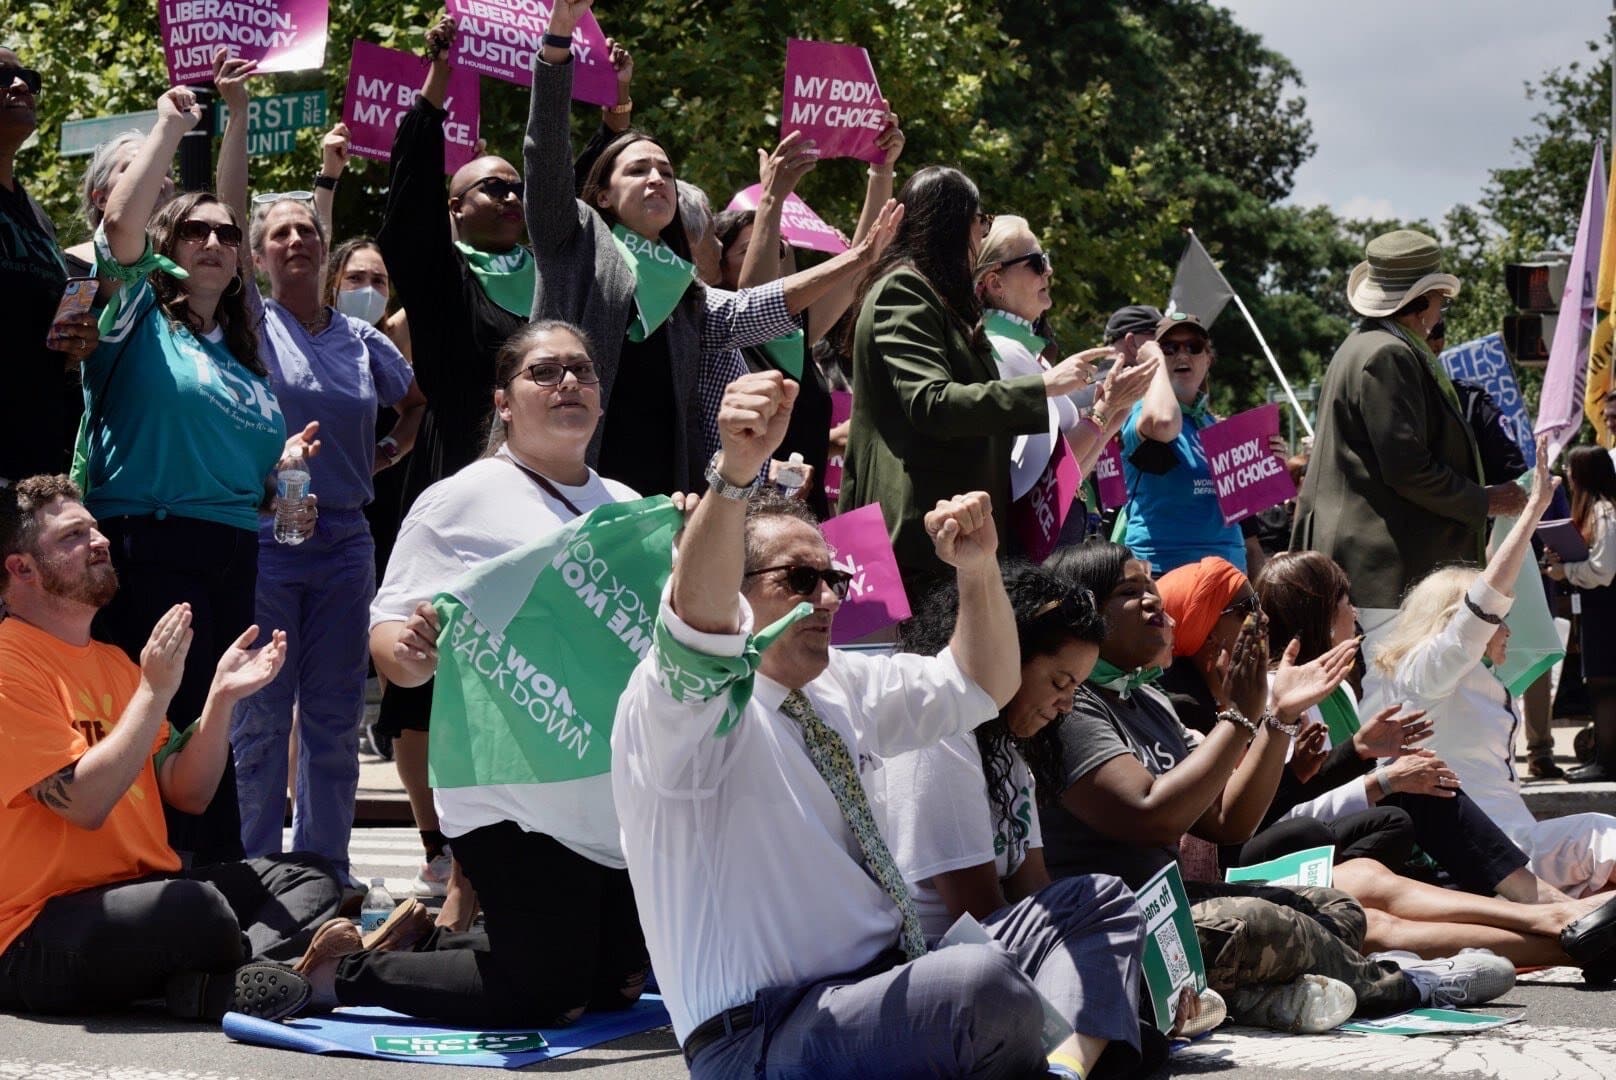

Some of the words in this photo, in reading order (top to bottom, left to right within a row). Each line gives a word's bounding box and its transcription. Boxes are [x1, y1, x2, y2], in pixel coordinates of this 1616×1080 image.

[166, 0, 298, 30] LIBERATION.
[455, 0, 590, 45] LIBERATIN.
[458, 15, 595, 66] AUTONY.
[357, 75, 394, 102] MY
[794, 75, 829, 99] MY
[829, 79, 877, 107] BODY,
[220, 97, 299, 133] FRST
[303, 96, 321, 110] ST
[303, 110, 321, 124] NE
[352, 100, 392, 128] MY
[790, 102, 824, 126] MY
[824, 105, 886, 132] CHOICE.
[623, 233, 686, 271] BACK
[1211, 450, 1231, 475] MY
[1230, 438, 1264, 468] BODY,
[1217, 472, 1237, 499] MY
[1236, 455, 1284, 489] CHOICE.
[450, 620, 512, 690] BACK
[509, 680, 590, 761] DOWN
[1159, 883, 1173, 909] off
